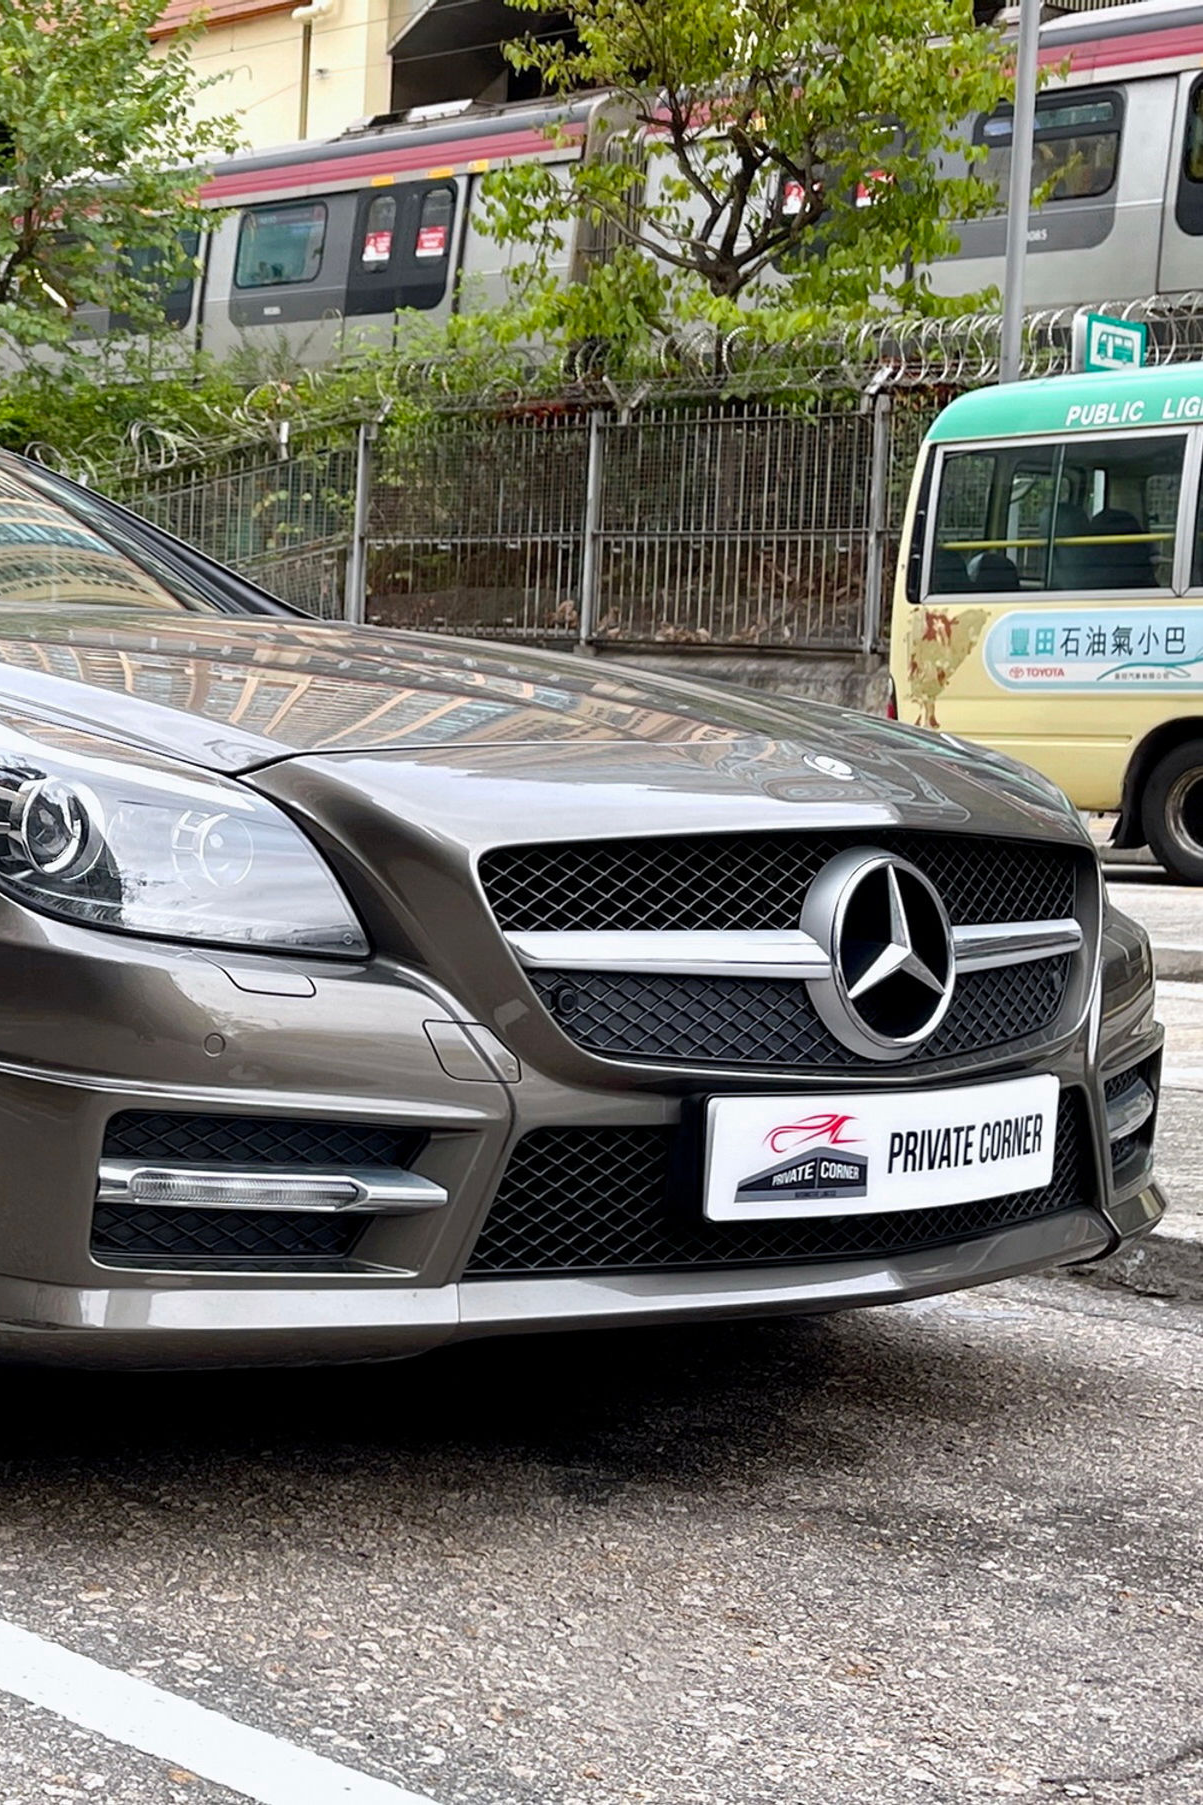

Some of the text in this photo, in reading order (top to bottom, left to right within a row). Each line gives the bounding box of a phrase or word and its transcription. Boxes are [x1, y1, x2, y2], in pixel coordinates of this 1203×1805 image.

[1065, 400, 1145, 426] PUBLIC
[1025, 666, 1065, 678] TOYOTA
[887, 1113, 1044, 1174] PRIVATE CORNER
[771, 1161, 860, 1187] PRIVATE CORNER
